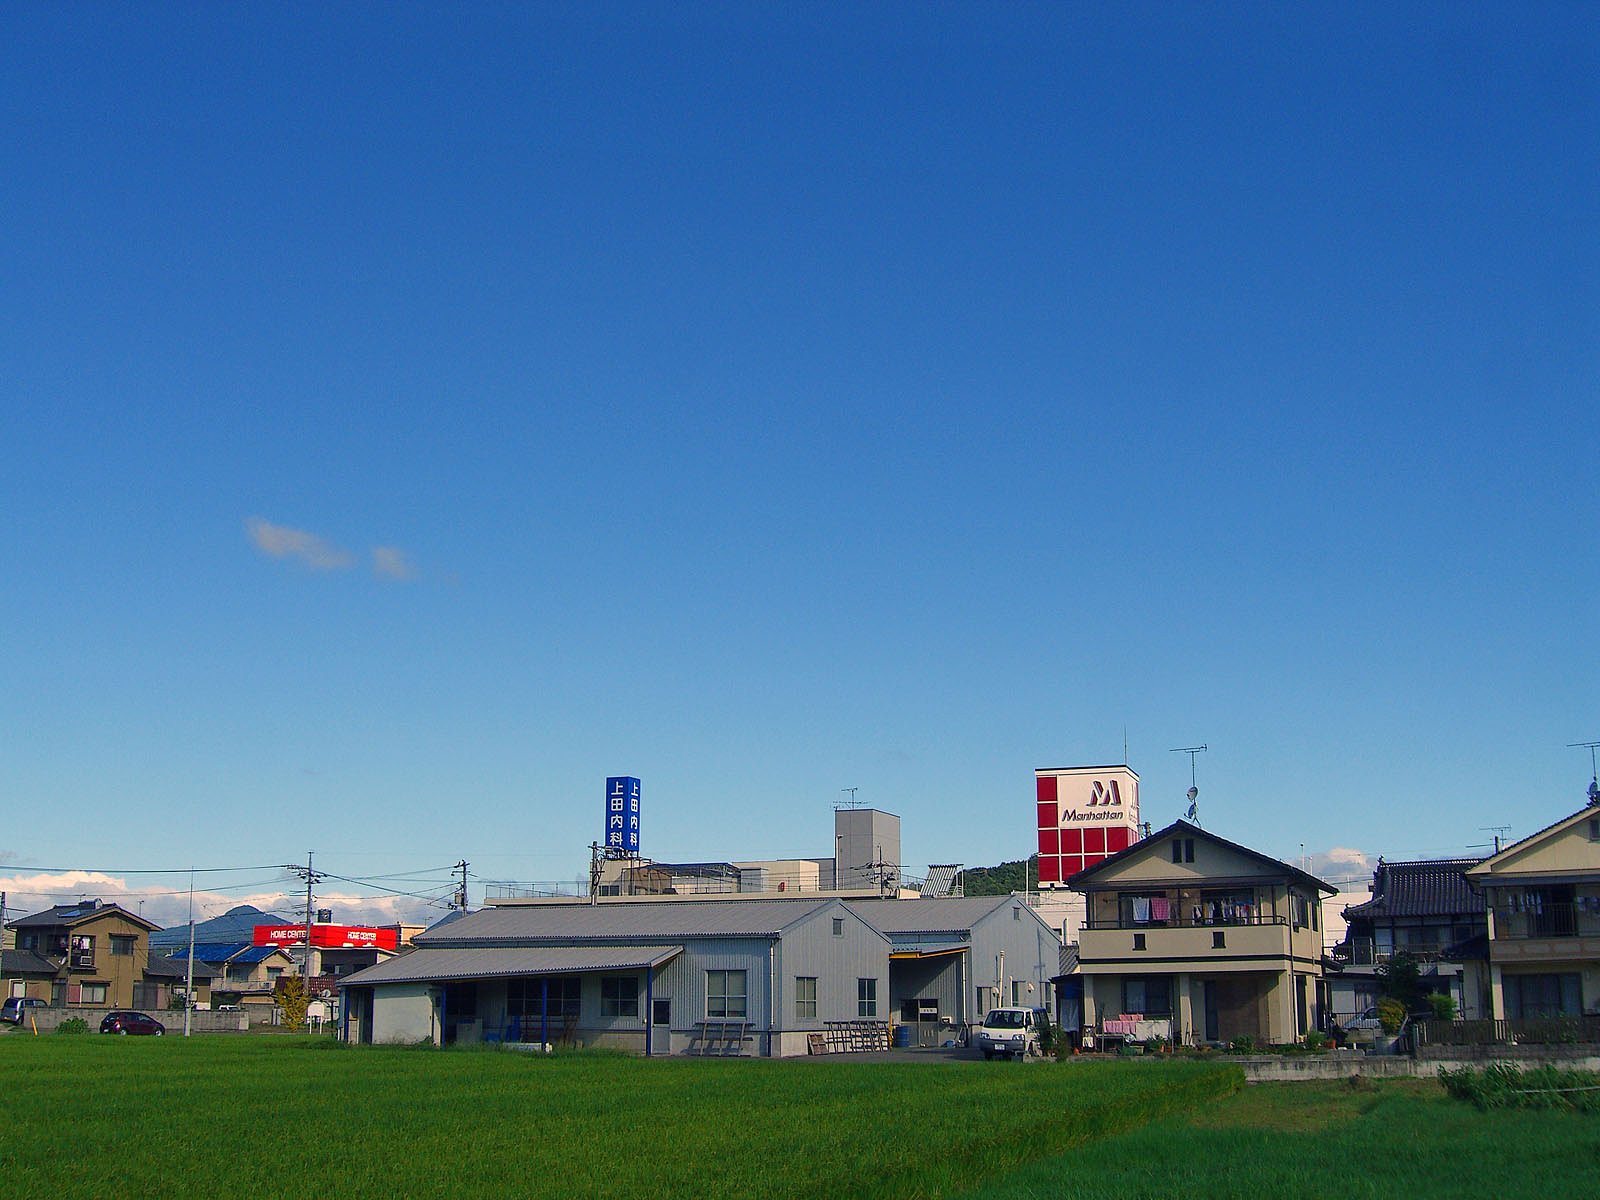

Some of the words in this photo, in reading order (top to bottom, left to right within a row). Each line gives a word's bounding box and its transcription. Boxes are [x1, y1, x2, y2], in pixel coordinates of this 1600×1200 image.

[609, 781, 624, 846] 上田内科
[630, 782, 639, 847] 上田内科
[1062, 809, 1123, 822] Manhattan
[270, 930, 286, 938] HOME
[287, 930, 307, 939] CENTE
[347, 931, 360, 939] HOME
[360, 932, 377, 941] CENTER
